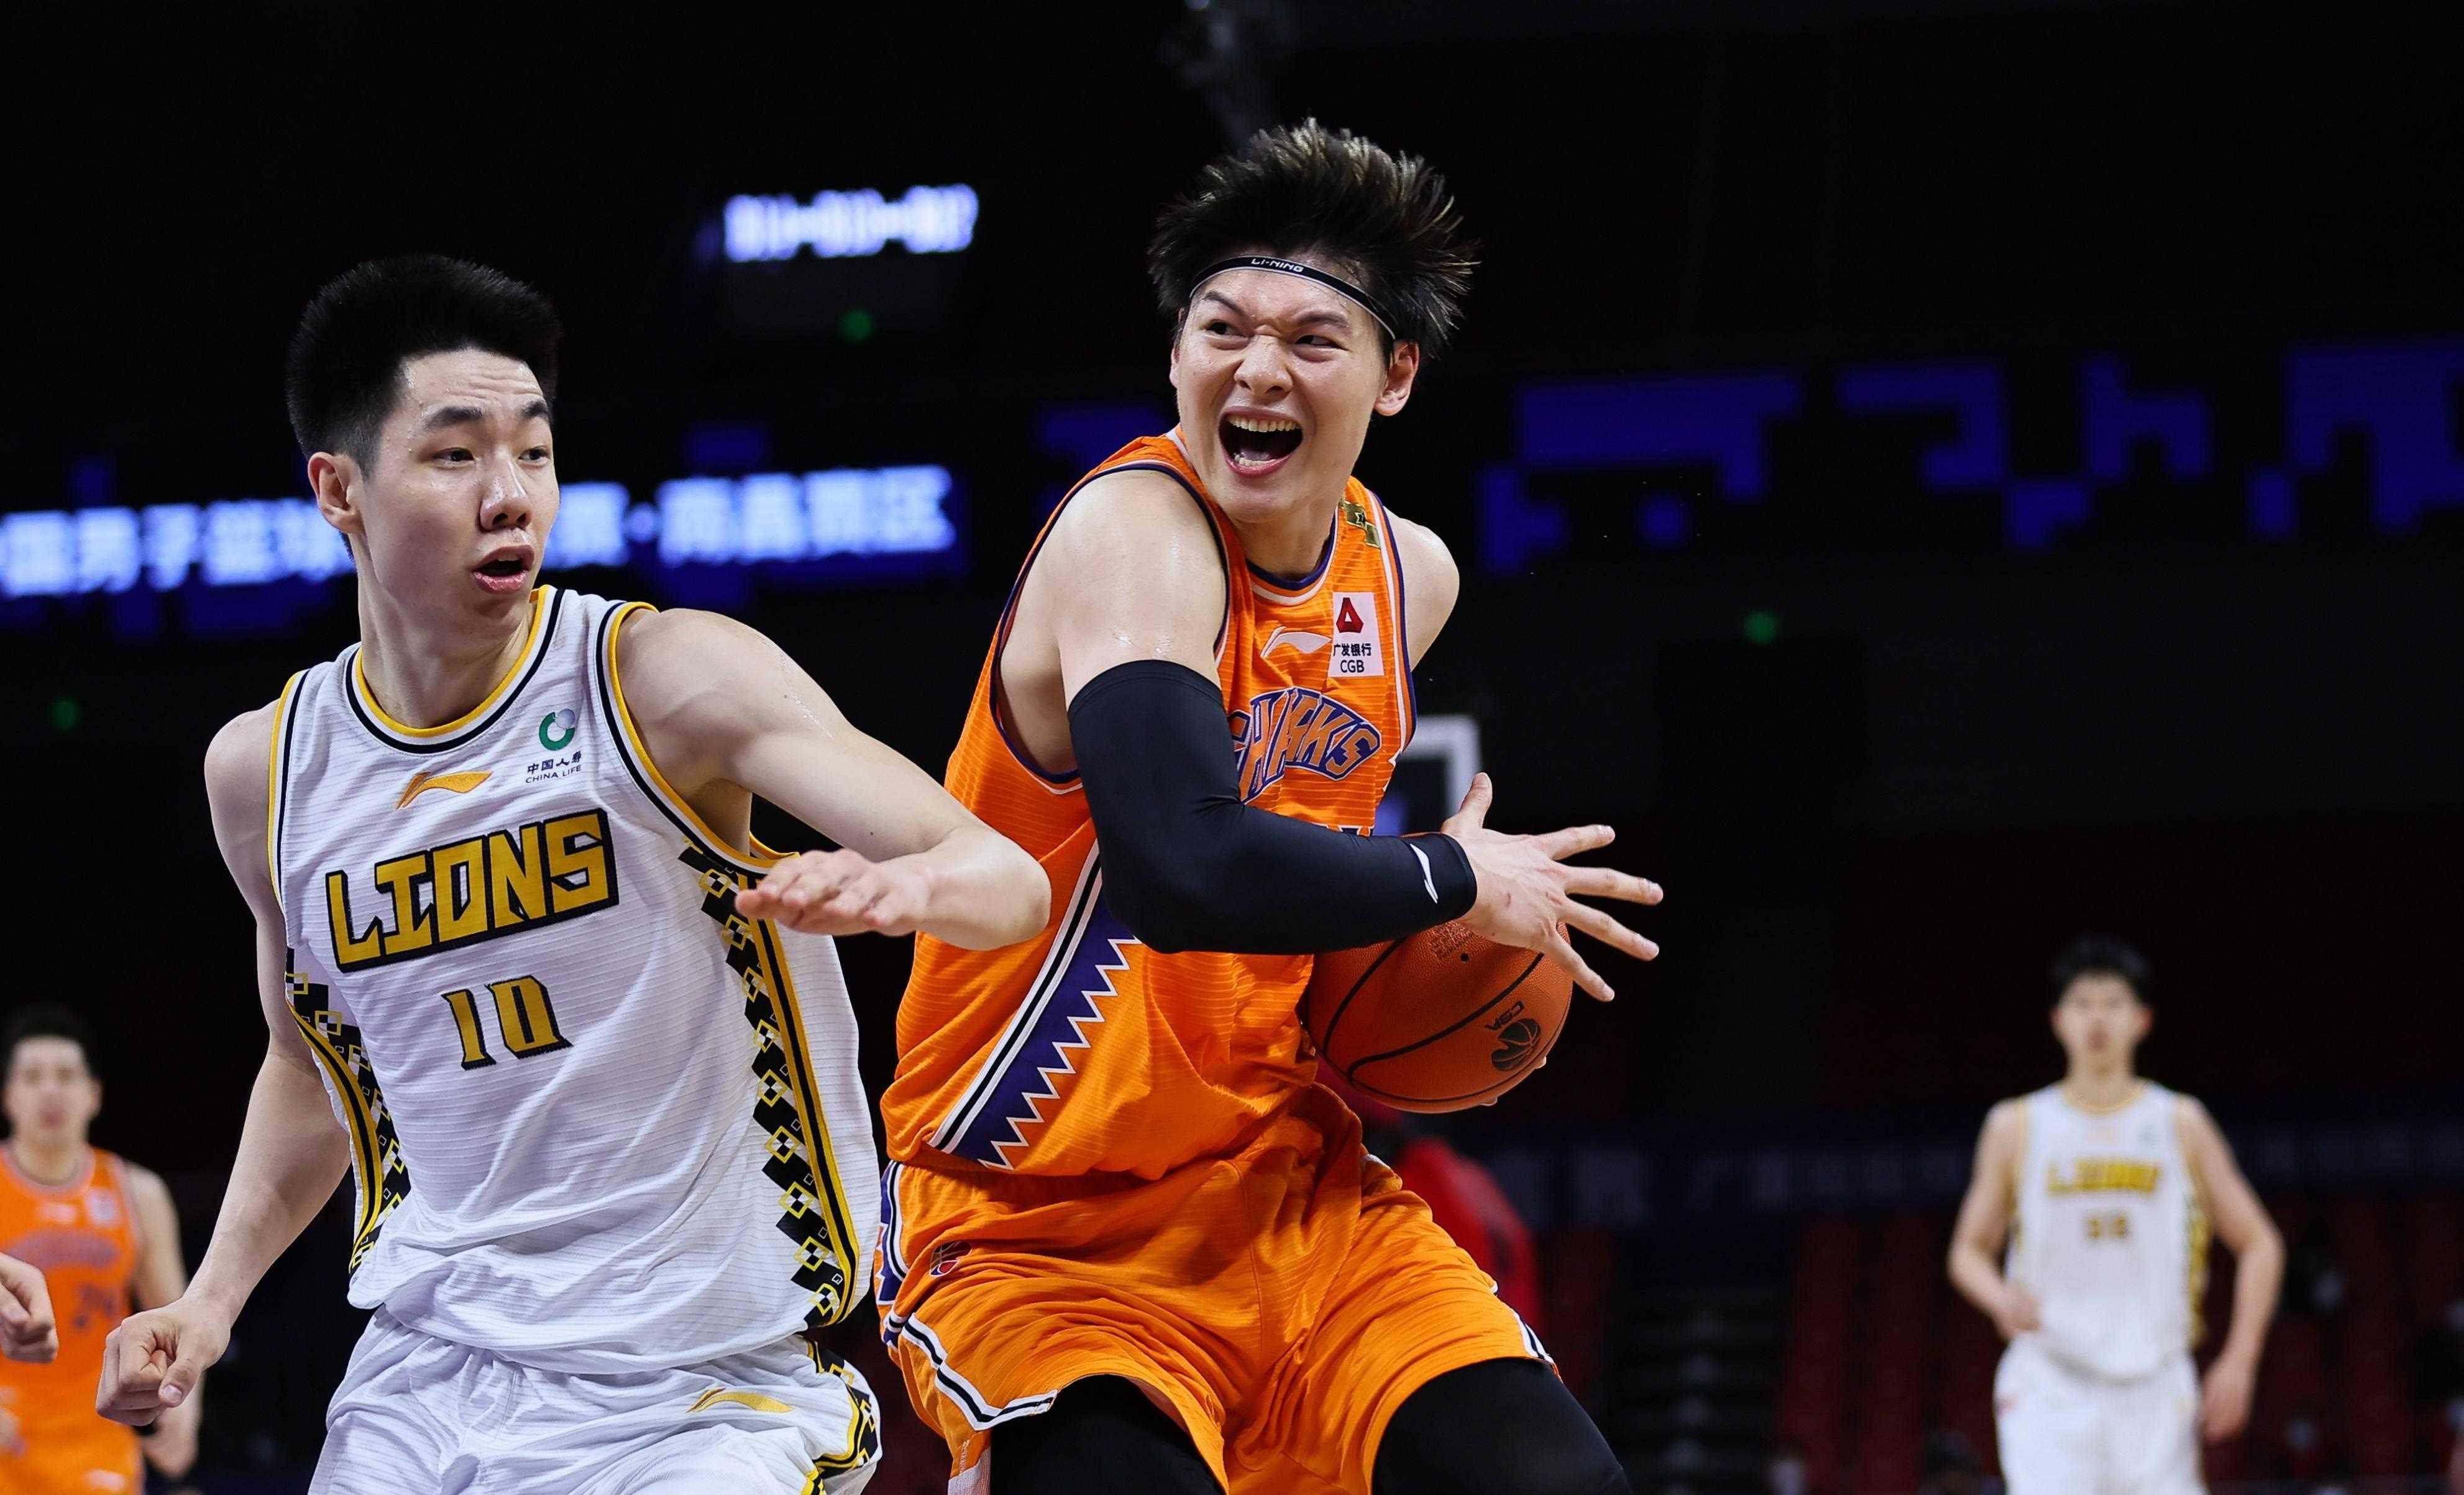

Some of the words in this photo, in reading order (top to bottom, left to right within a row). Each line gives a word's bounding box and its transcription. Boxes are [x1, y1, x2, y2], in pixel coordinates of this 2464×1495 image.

[1250, 258, 1304, 273] LI-NING
[1332, 643, 1372, 656] 广发银行
[1340, 660, 1365, 673] CGB
[527, 750, 582, 774] 中国人寿
[525, 772, 559, 784] CHINA
[562, 764, 582, 777] LIFE
[325, 808, 620, 974] LIONS
[441, 974, 574, 1071] 10
[1484, 1001, 1525, 1031] CBA
